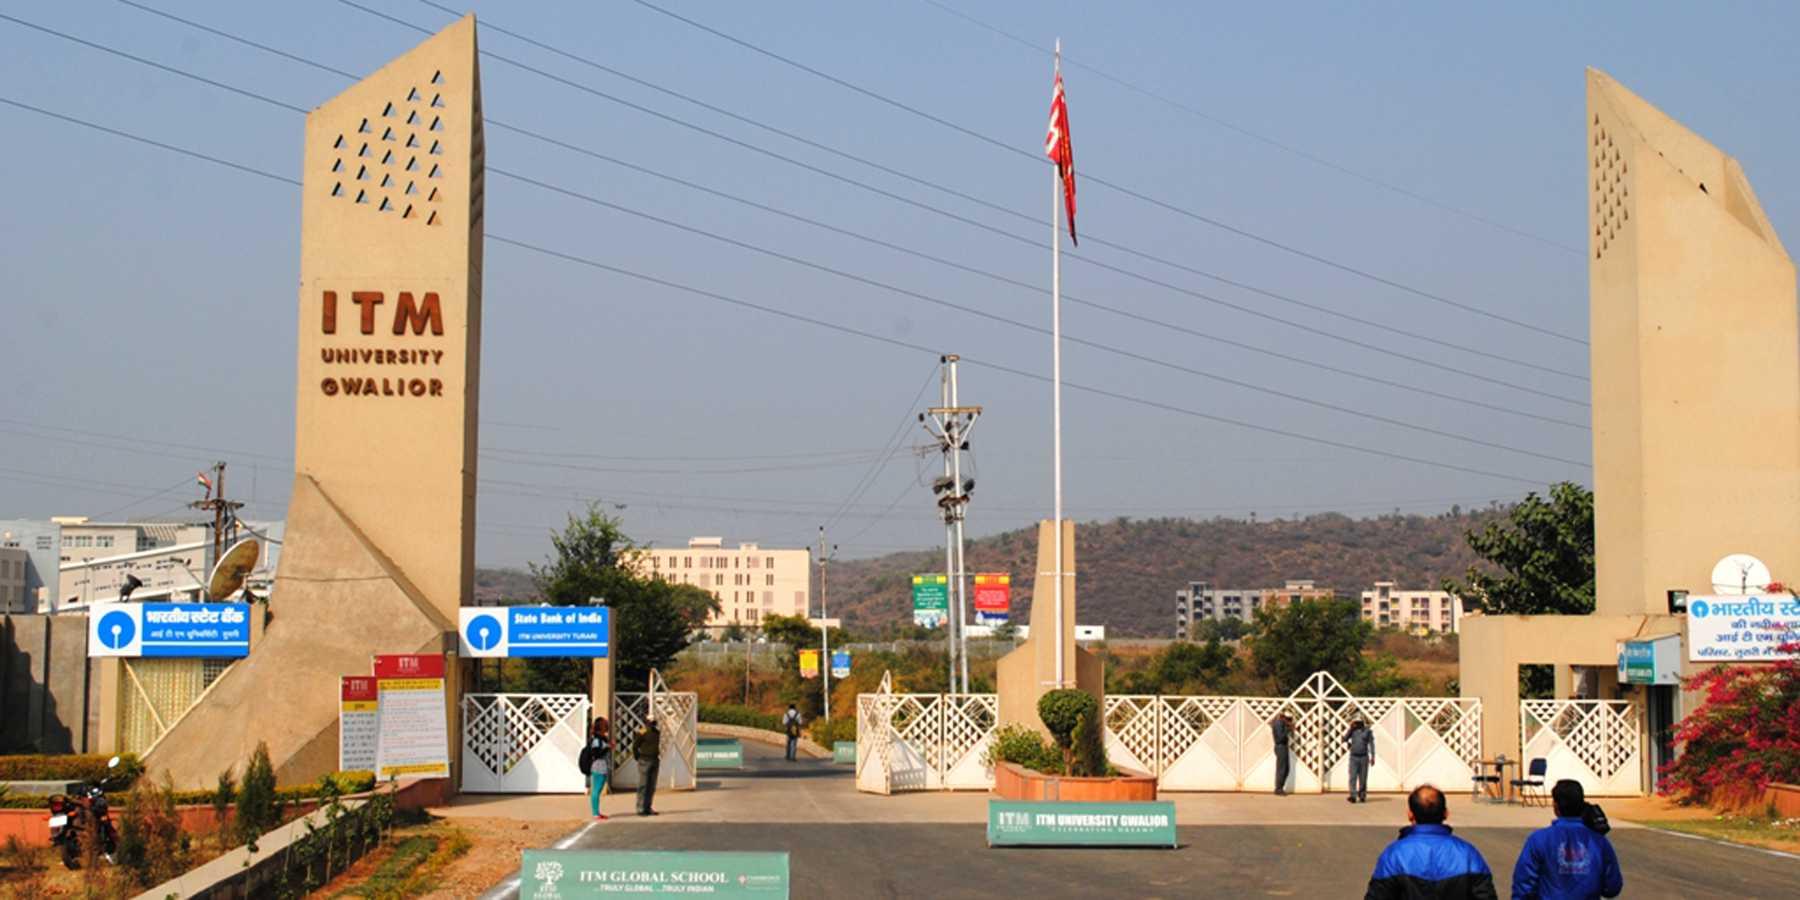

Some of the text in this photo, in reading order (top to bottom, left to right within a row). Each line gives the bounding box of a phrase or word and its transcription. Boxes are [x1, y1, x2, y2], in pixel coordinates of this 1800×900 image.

[322, 291, 443, 335] ITM
[321, 348, 443, 364] UNIVERSITY
[320, 377, 443, 396] GWALIOR
[1711, 597, 1774, 616] भारतीय
[146, 606, 244, 623] भारतीय स्टेट बैंक
[514, 612, 602, 624] State Bank of India
[398, 657, 419, 669] ITM
[998, 812, 1029, 826] ITM
[1036, 814, 1168, 827] ITM UNIVERSITY GWALIOR
[580, 871, 729, 884] ITM GLOBAL SCHOOL
